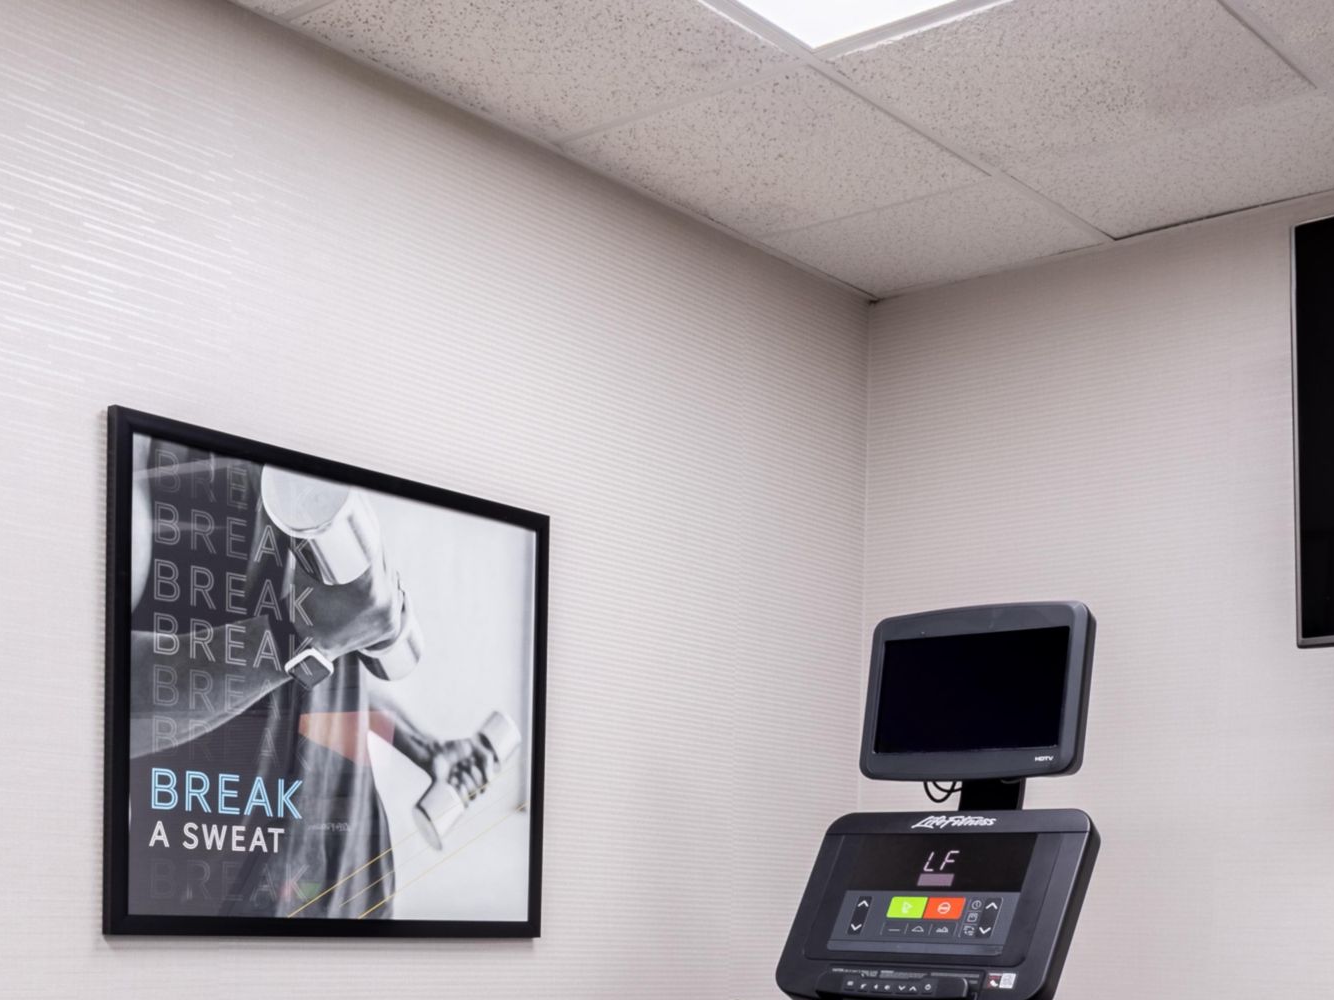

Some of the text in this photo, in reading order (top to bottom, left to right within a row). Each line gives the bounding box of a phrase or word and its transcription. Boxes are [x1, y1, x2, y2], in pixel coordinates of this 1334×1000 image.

[154, 500, 315, 574] BREAK
[153, 558, 314, 627] BREAK
[153, 612, 314, 677] BREAK
[151, 767, 303, 820] BREAK
[148, 820, 286, 854] A SWEAT
[923, 850, 960, 872] LF
